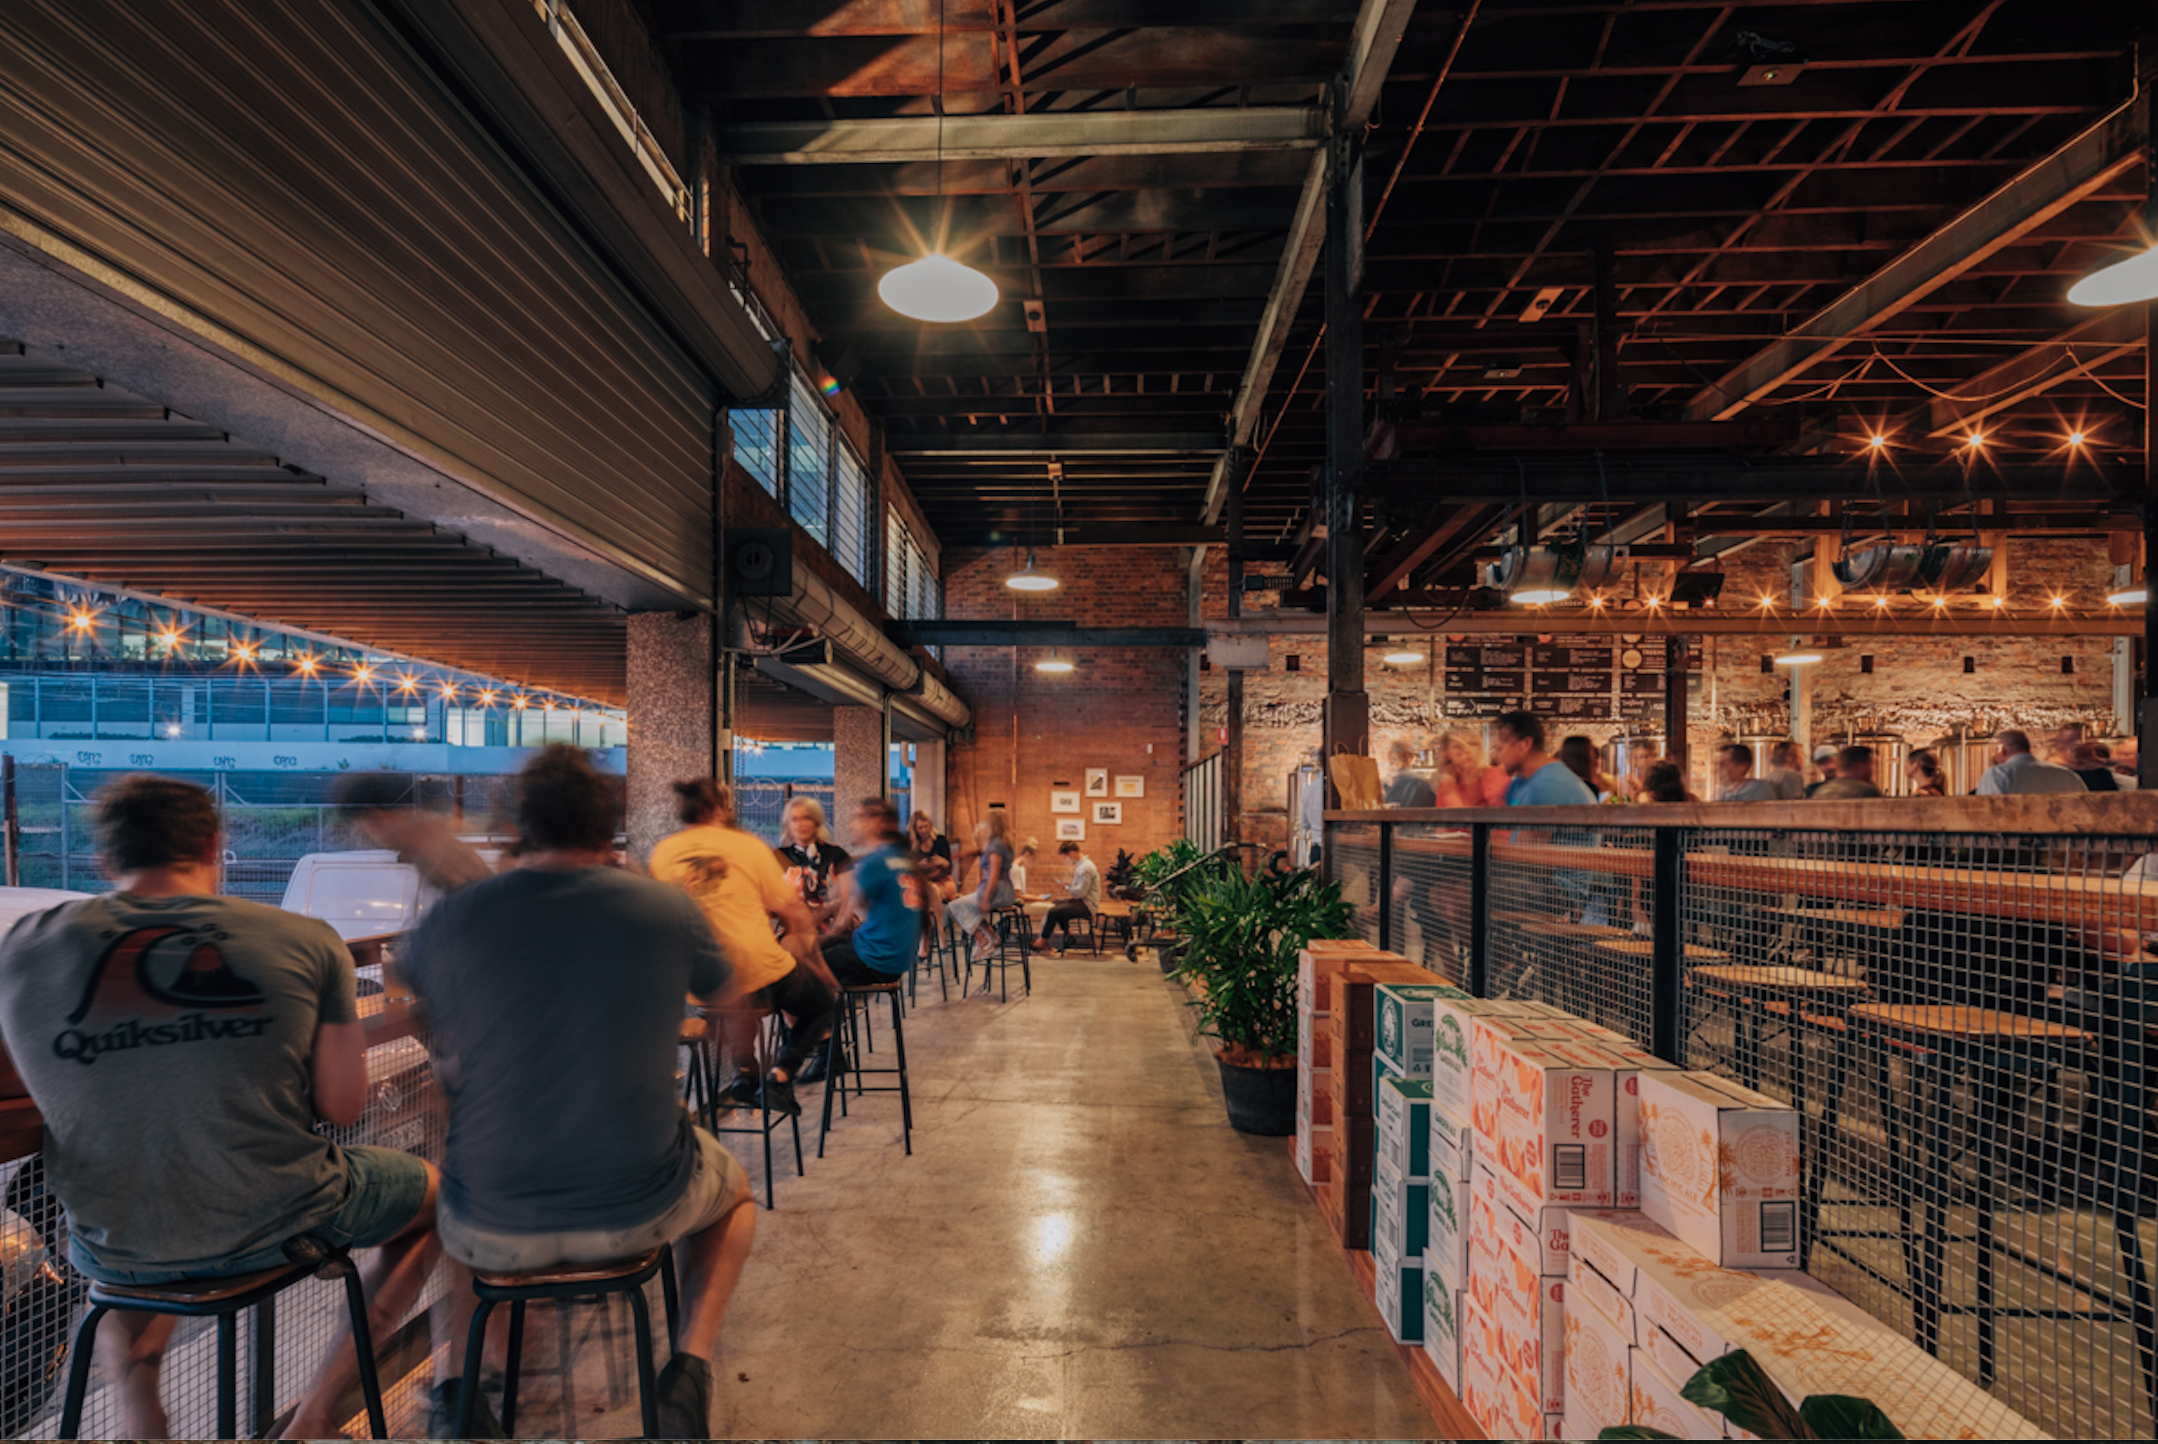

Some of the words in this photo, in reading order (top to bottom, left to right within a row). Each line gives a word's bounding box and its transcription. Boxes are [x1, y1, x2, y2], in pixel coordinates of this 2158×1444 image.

[53, 1011, 275, 1066] Quiksilver
[1583, 1076, 1593, 1097] The
[1501, 1090, 1530, 1121] Gatherer
[1570, 1075, 1583, 1139] Gatherer
[1659, 1172, 1684, 1195] PACIFIC
[1684, 1190, 1698, 1203] ALE
